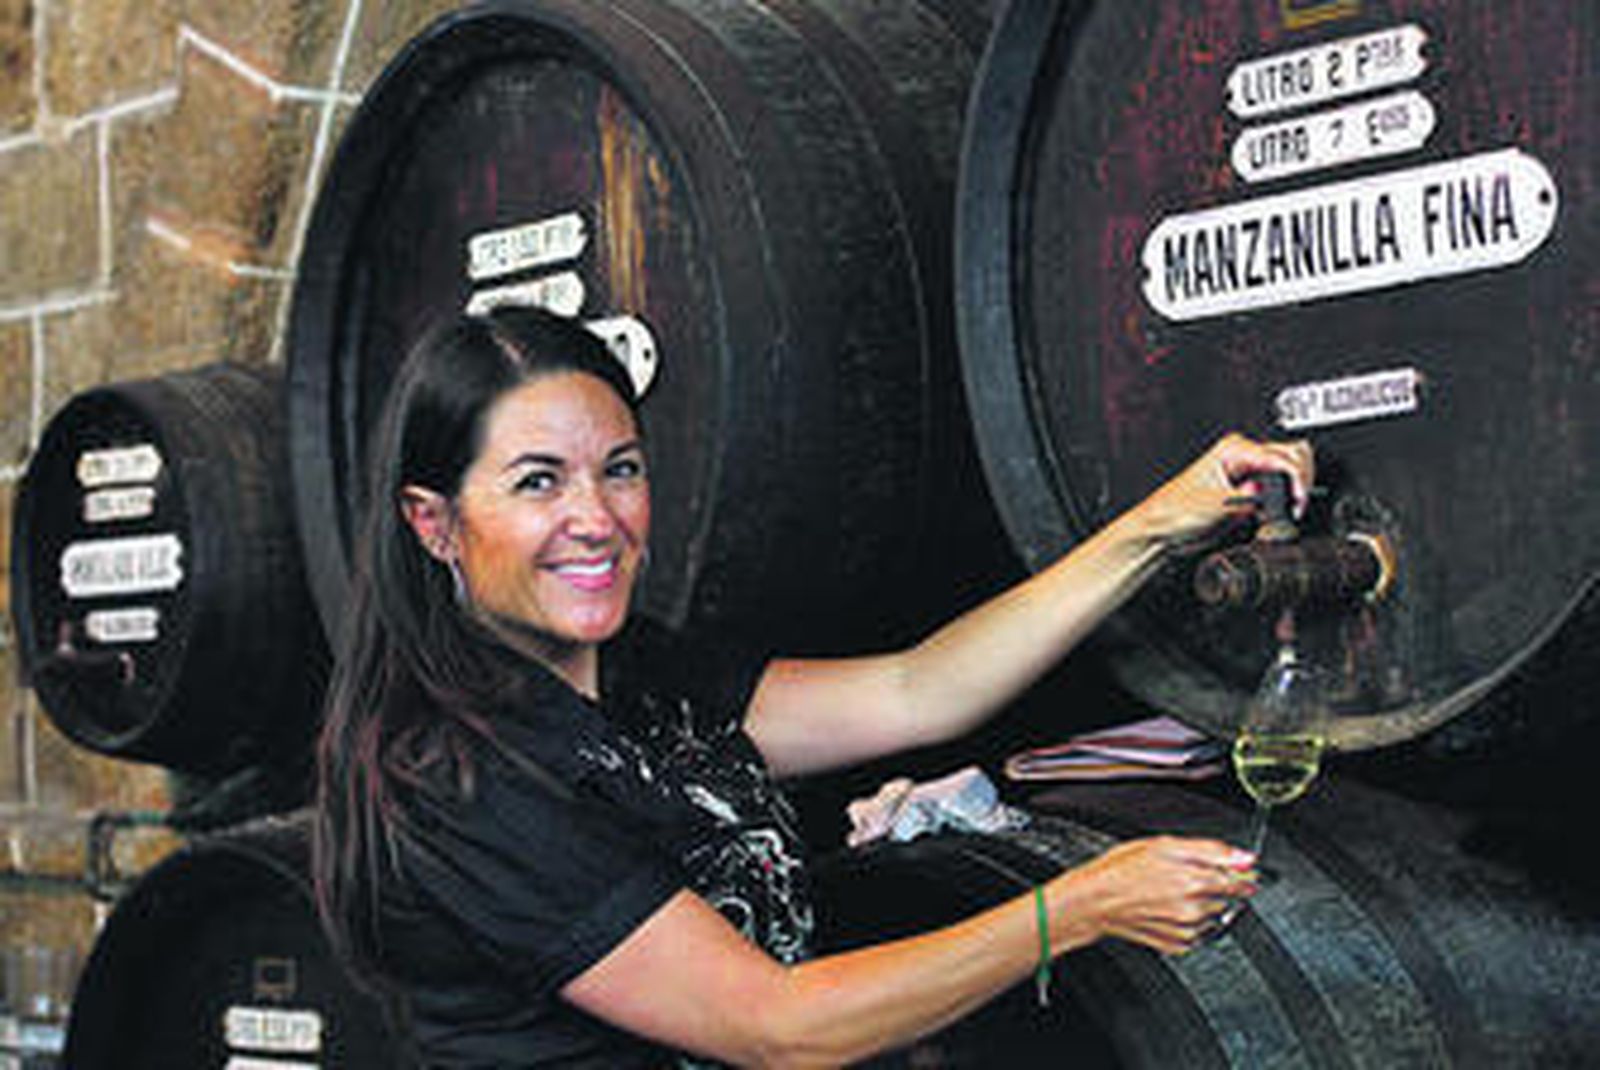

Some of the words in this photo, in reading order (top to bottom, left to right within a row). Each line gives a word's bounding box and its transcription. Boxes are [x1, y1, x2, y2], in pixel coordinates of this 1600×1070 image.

[1241, 57, 1314, 106] LITRO
[1327, 50, 1343, 88] 2
[1163, 194, 1401, 301] MANZANILLA
[1422, 174, 1519, 256] FINA
